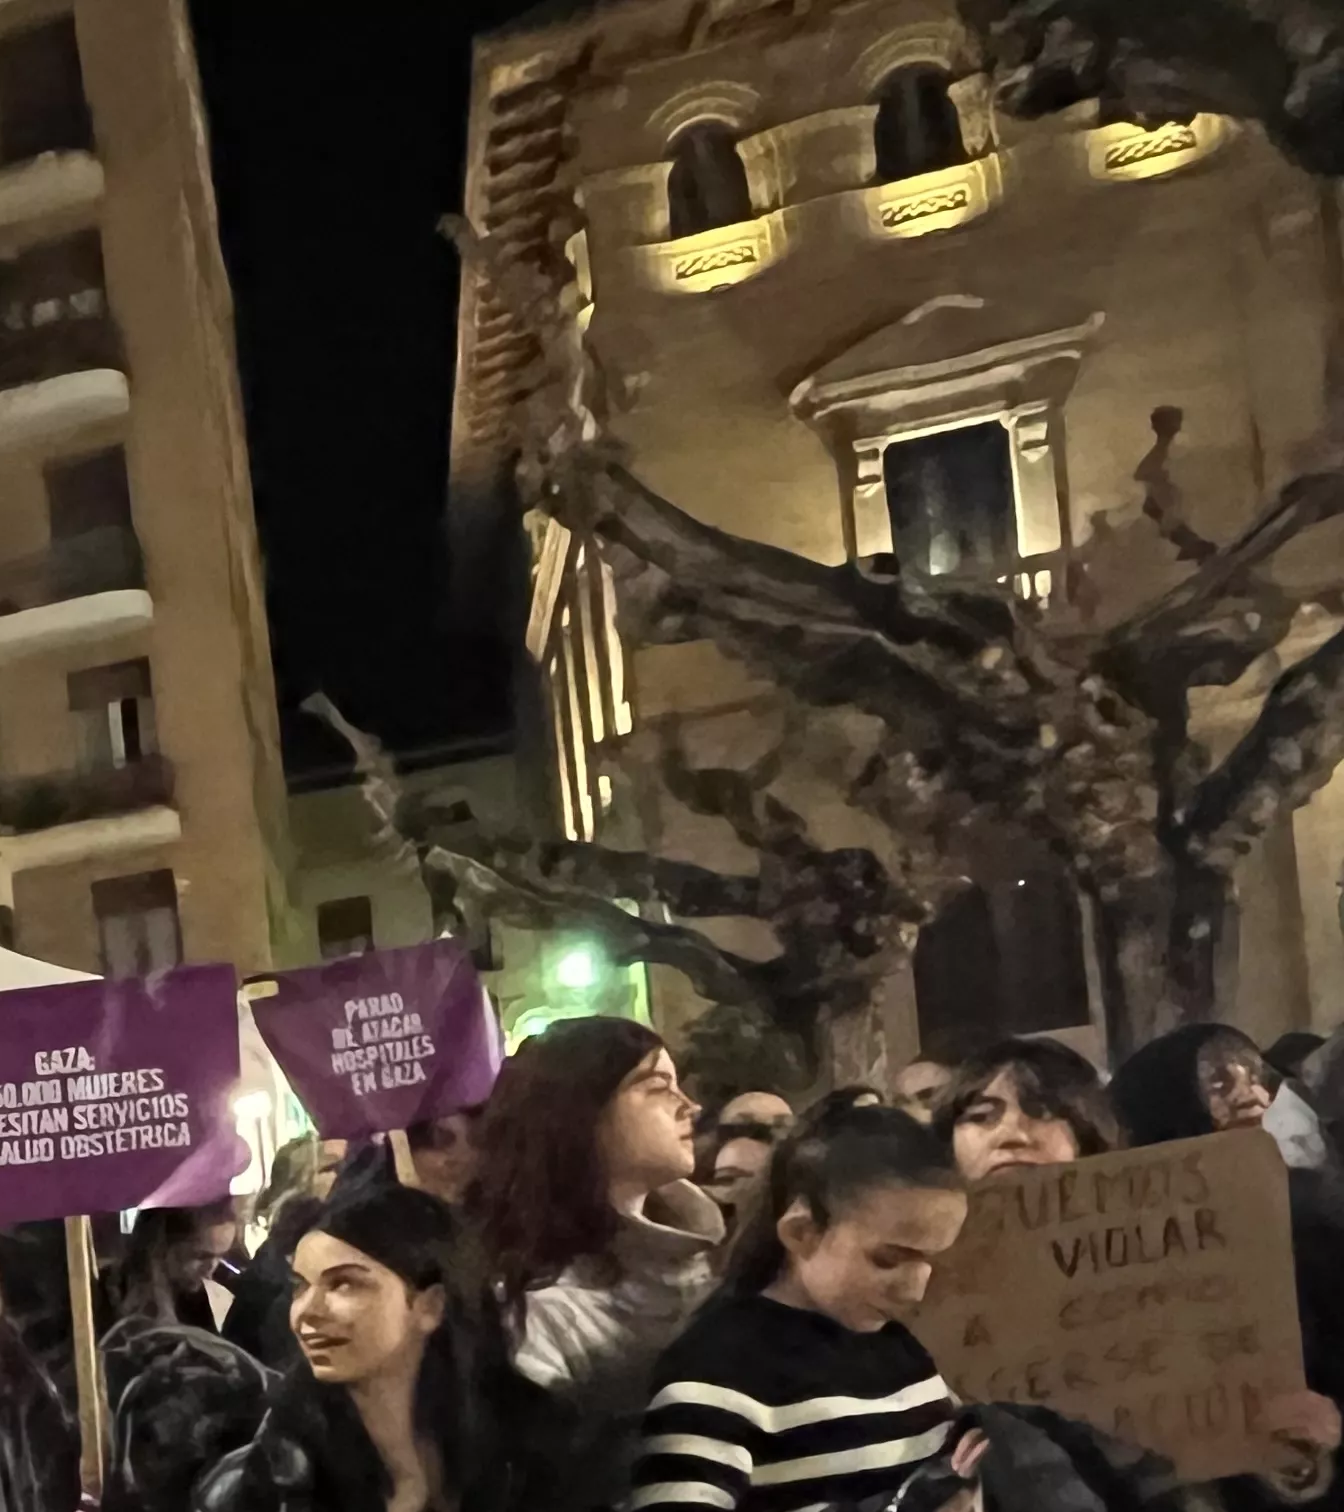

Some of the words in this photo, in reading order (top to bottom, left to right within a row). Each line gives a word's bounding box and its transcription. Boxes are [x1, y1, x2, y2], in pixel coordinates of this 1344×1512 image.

[35, 1046, 96, 1075] GAZA:
[331, 1035, 436, 1074] HOSPITALES
[67, 1067, 165, 1103] MUJERES
[381, 1061, 427, 1089] GAZA
[73, 1093, 189, 1132] SERVICIOS
[1049, 1207, 1228, 1278] VIOLAR
